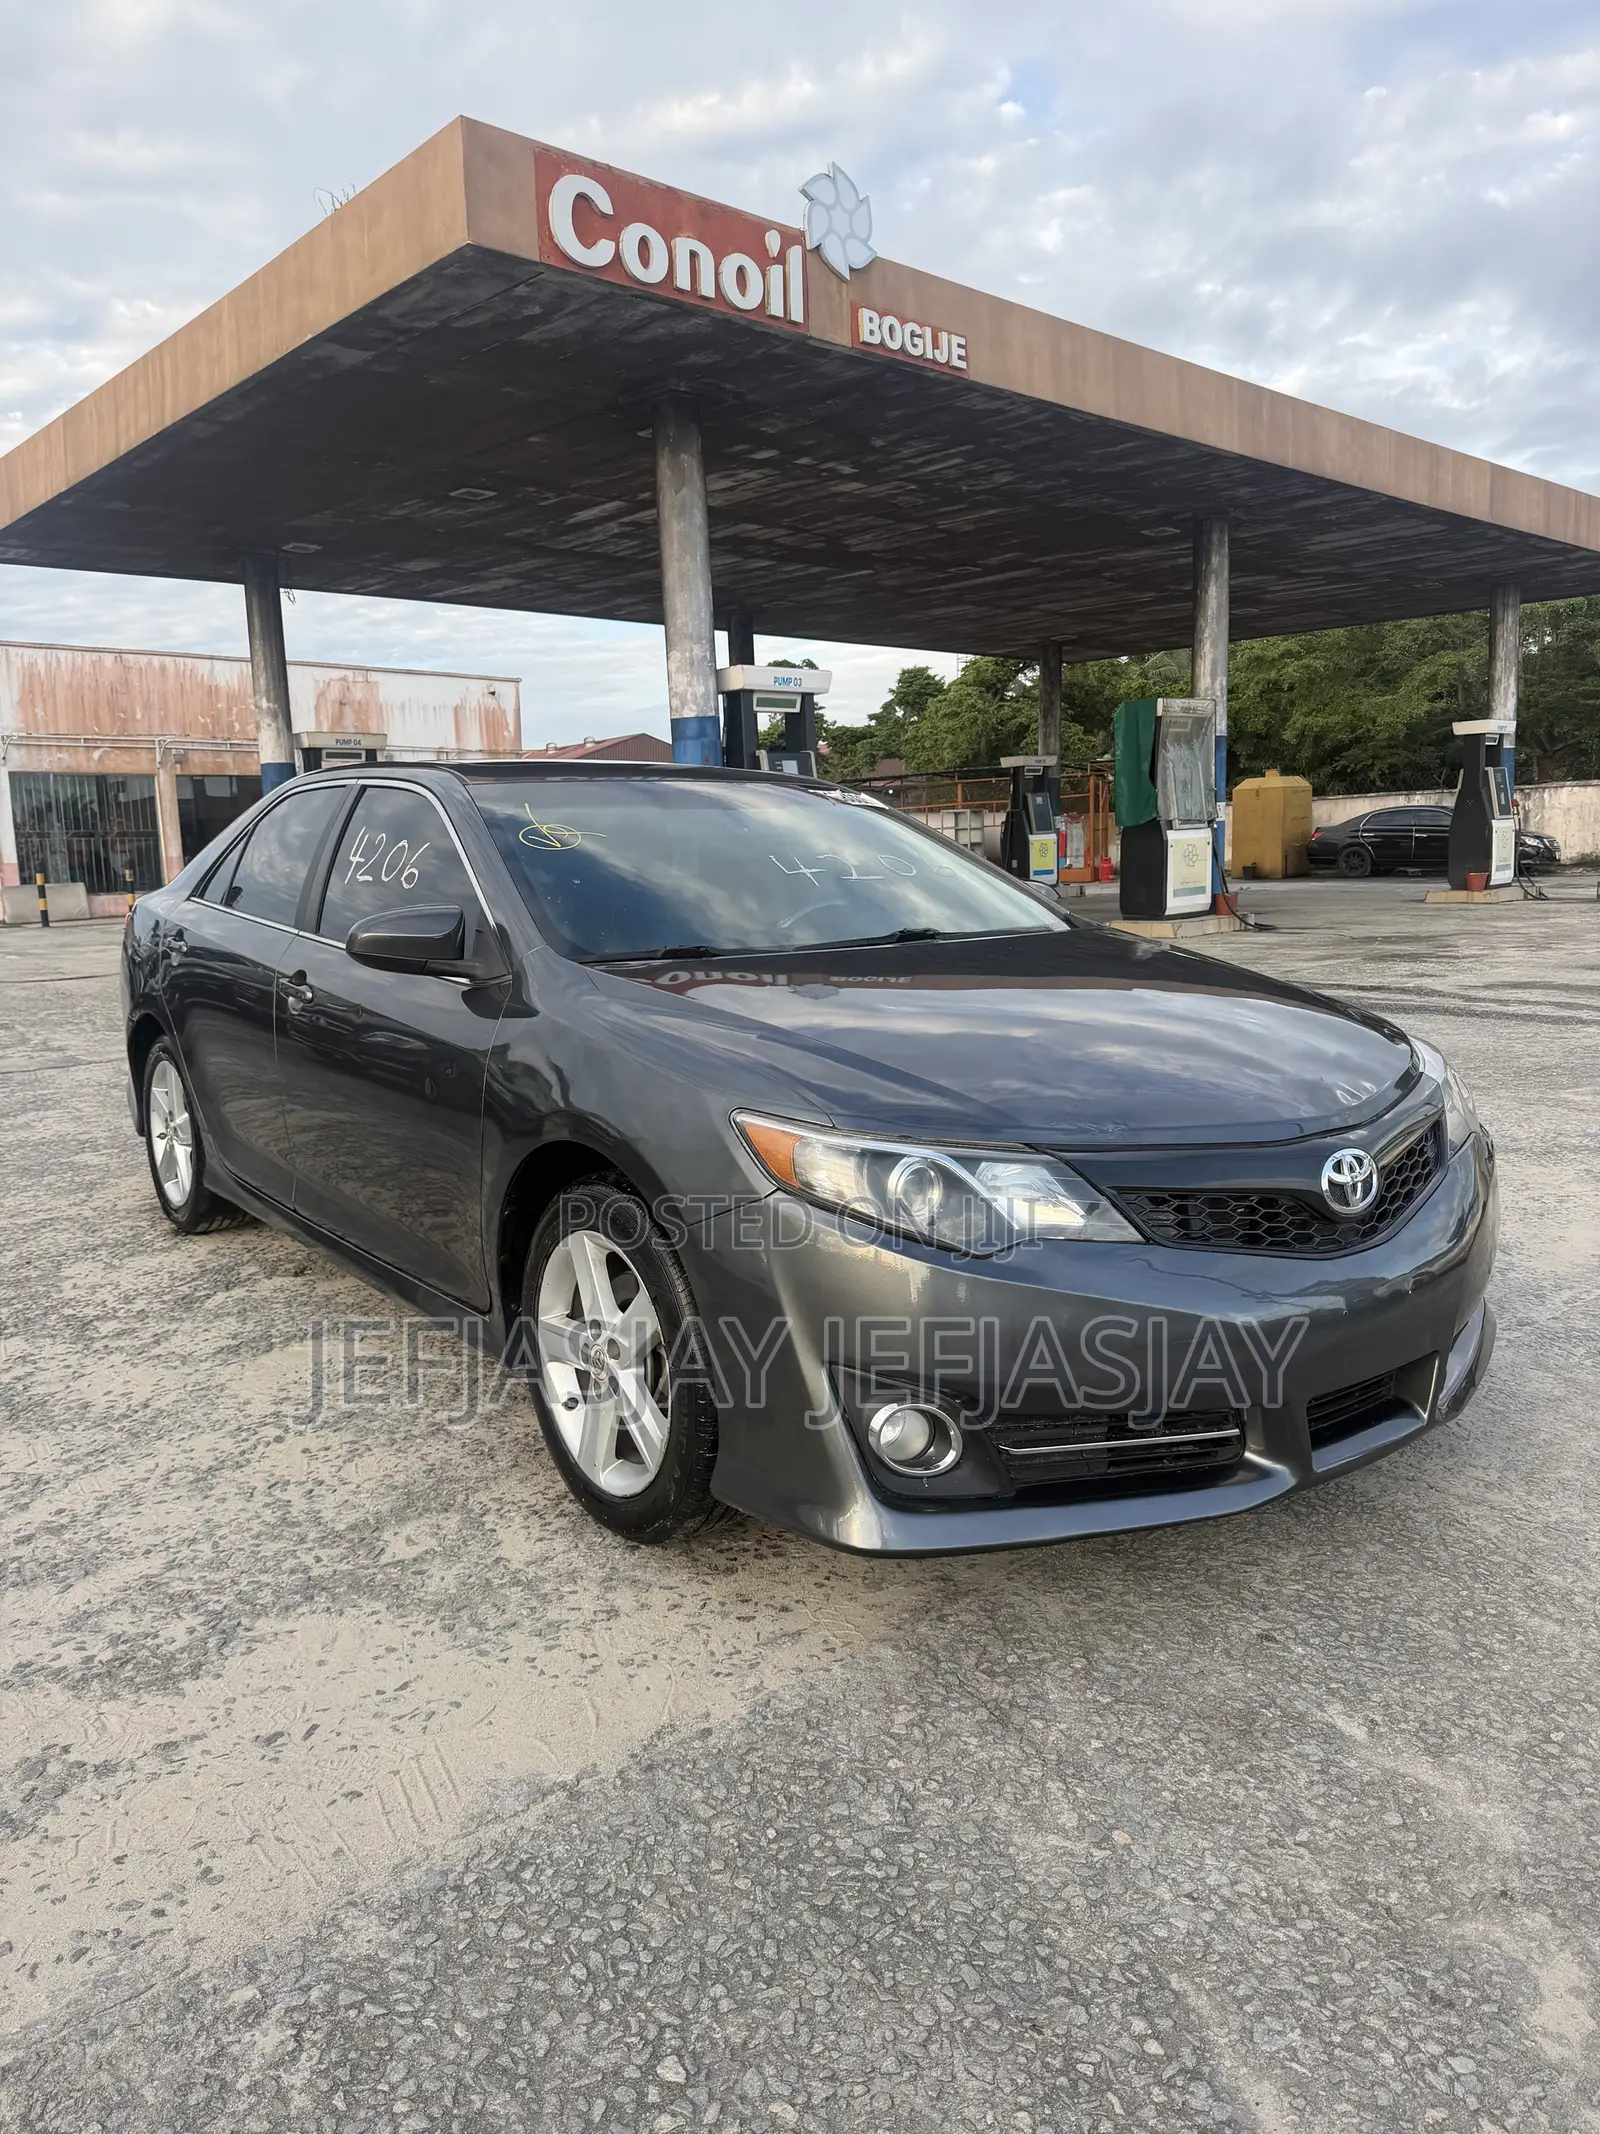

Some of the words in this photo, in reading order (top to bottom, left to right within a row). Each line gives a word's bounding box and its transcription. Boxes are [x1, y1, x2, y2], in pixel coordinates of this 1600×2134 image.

[548, 174, 804, 324] Conoil
[858, 307, 968, 370] BOGIJE
[774, 676, 793, 686] PUMP
[793, 677, 803, 687] 03
[335, 738, 352, 746] PUMP
[345, 826, 430, 889] 4206
